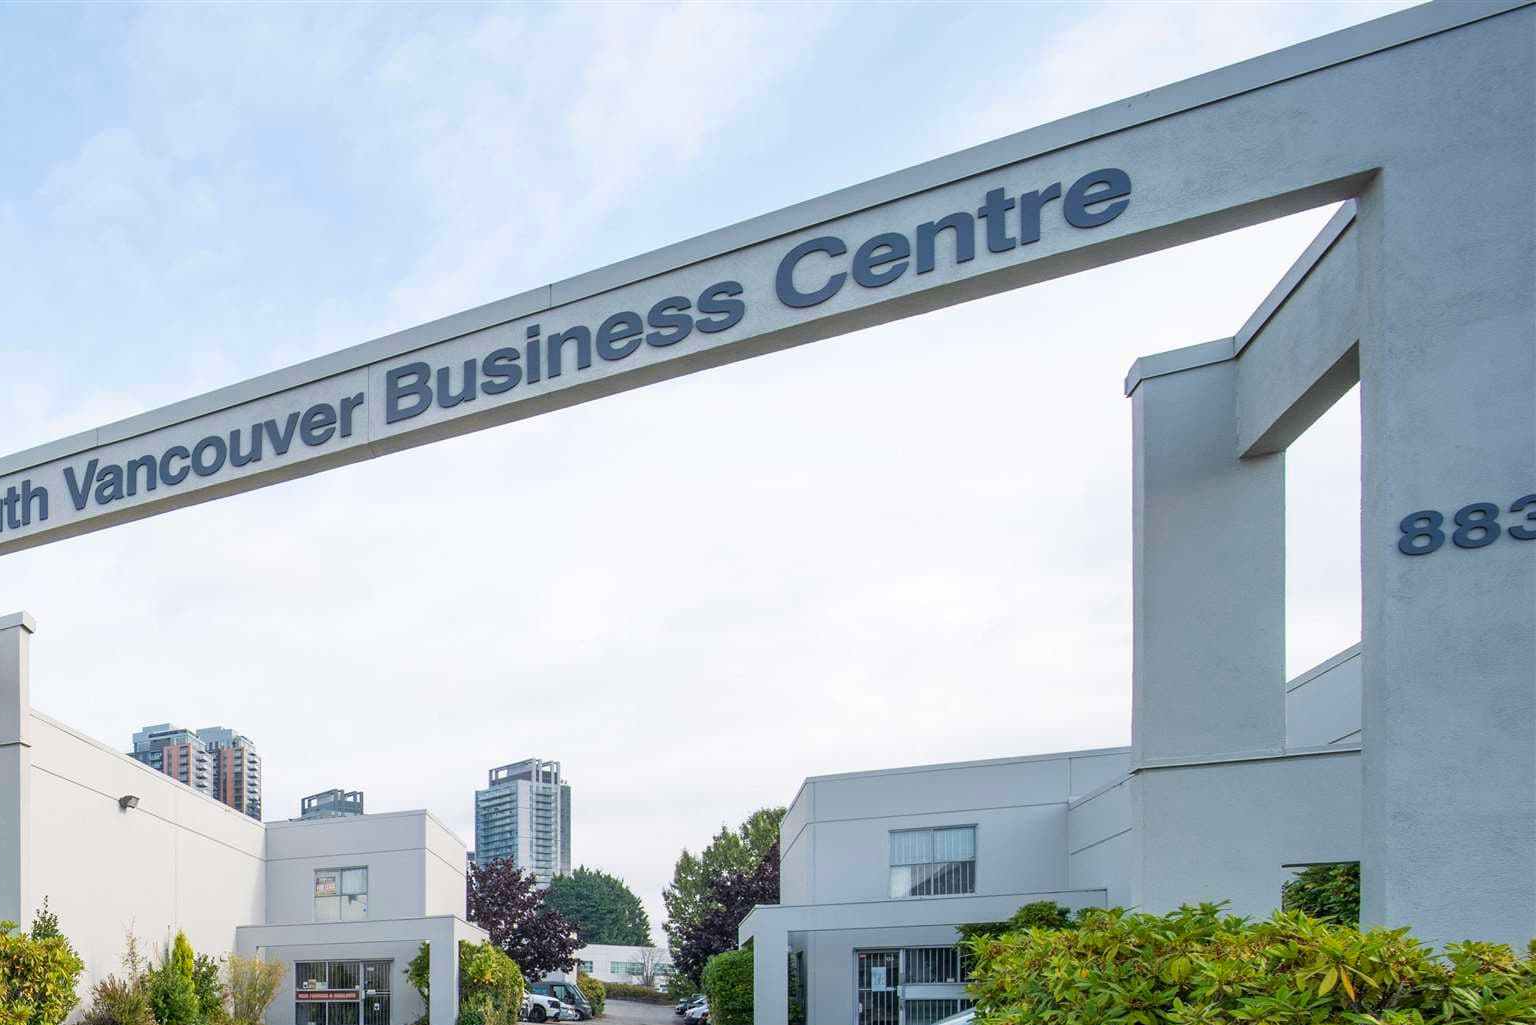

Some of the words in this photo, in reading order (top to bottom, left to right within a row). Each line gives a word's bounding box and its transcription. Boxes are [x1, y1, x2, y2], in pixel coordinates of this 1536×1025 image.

[63, 391, 364, 511] Vancouver
[385, 280, 745, 424] Business
[775, 167, 1131, 309] Centre
